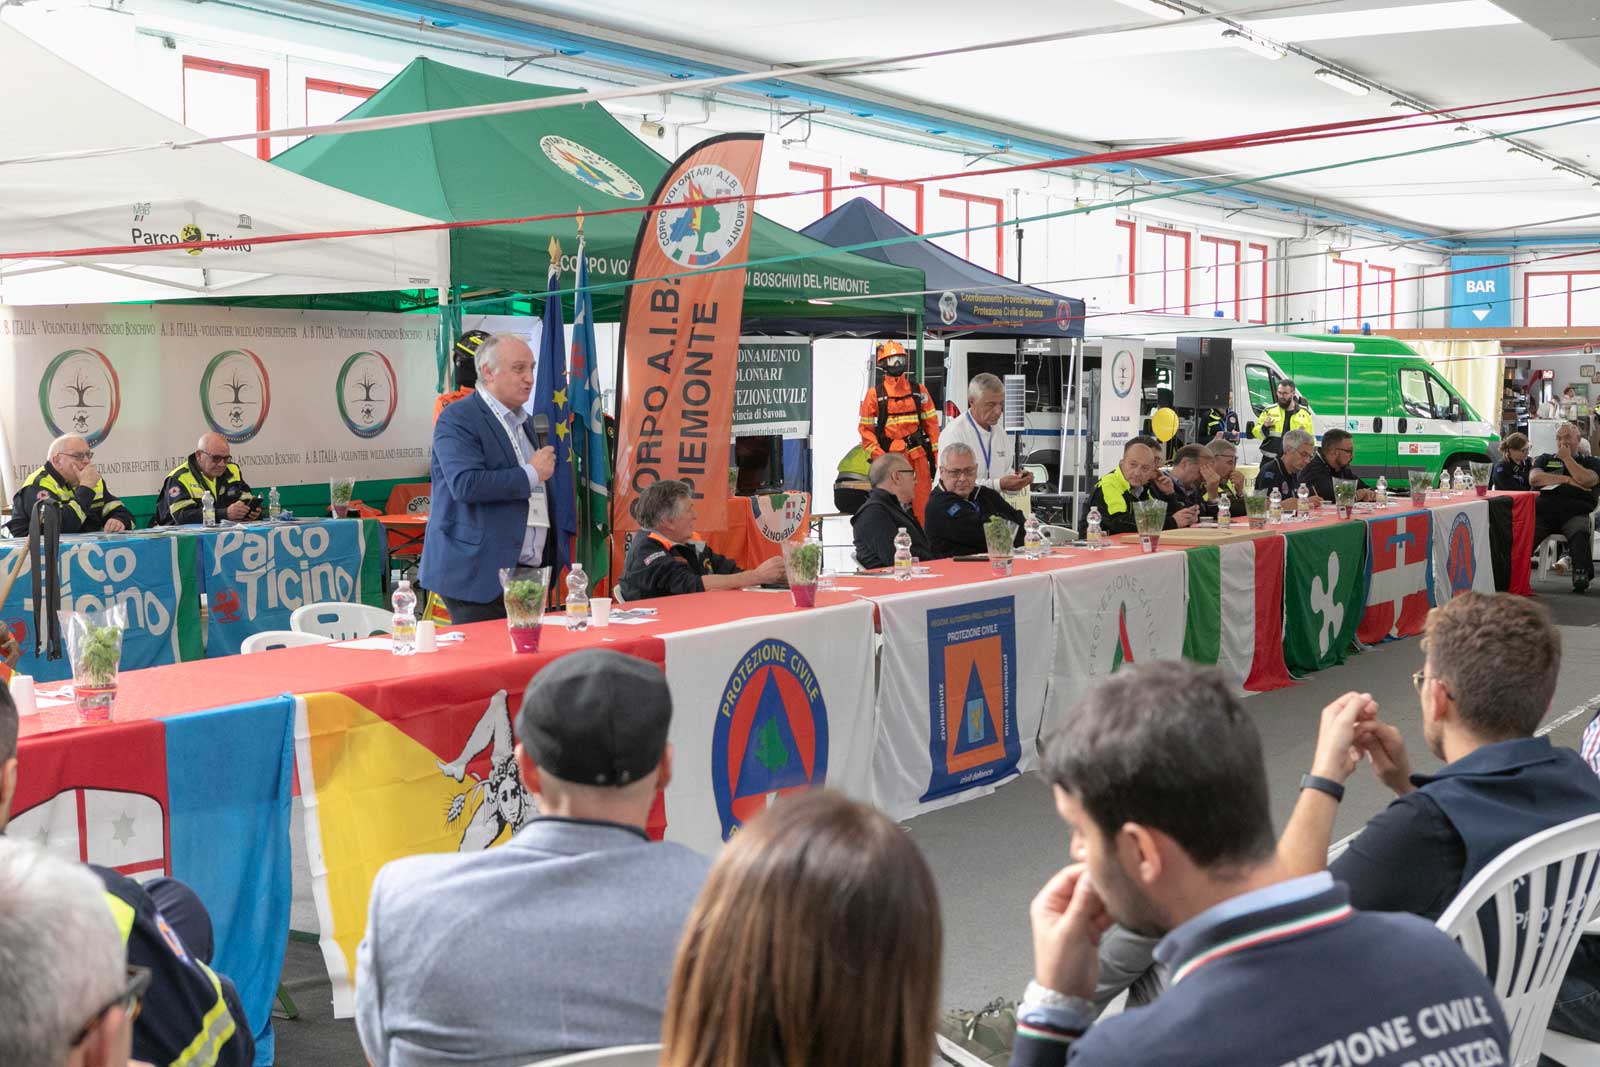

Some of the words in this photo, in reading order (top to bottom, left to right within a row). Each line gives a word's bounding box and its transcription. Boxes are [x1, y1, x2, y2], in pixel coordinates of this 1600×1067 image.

[664, 167, 713, 204] VOLONTARI
[716, 170, 738, 192] A.I.B.
[131, 228, 179, 247] Parco
[659, 210, 670, 247] CORPO
[726, 199, 745, 248] EMONTE
[560, 254, 608, 275] COPO
[753, 271, 801, 289] BOSCHIVI
[803, 273, 822, 289] DEL
[823, 275, 870, 294] PIEMONTE
[1466, 280, 1496, 294] BAR
[647, 277, 682, 375] A.I.B.
[677, 301, 718, 500] PIEMONTE
[734, 388, 773, 406] EZIONE
[772, 387, 808, 404] CIVILE
[754, 408, 762, 420] di
[762, 408, 787, 419] Savona
[212, 526, 330, 576] Parco
[236, 559, 354, 621] Ticino
[946, 626, 981, 642] PROTEZIONE
[981, 623, 999, 635] CIVILE
[722, 643, 787, 718] PROTEZIONE
[790, 654, 819, 703] CIVILE
[1279, 1015, 1417, 1067] EZIONE
[1416, 995, 1493, 1040] CIVILE
[1401, 1036, 1504, 1067] RUZZO
